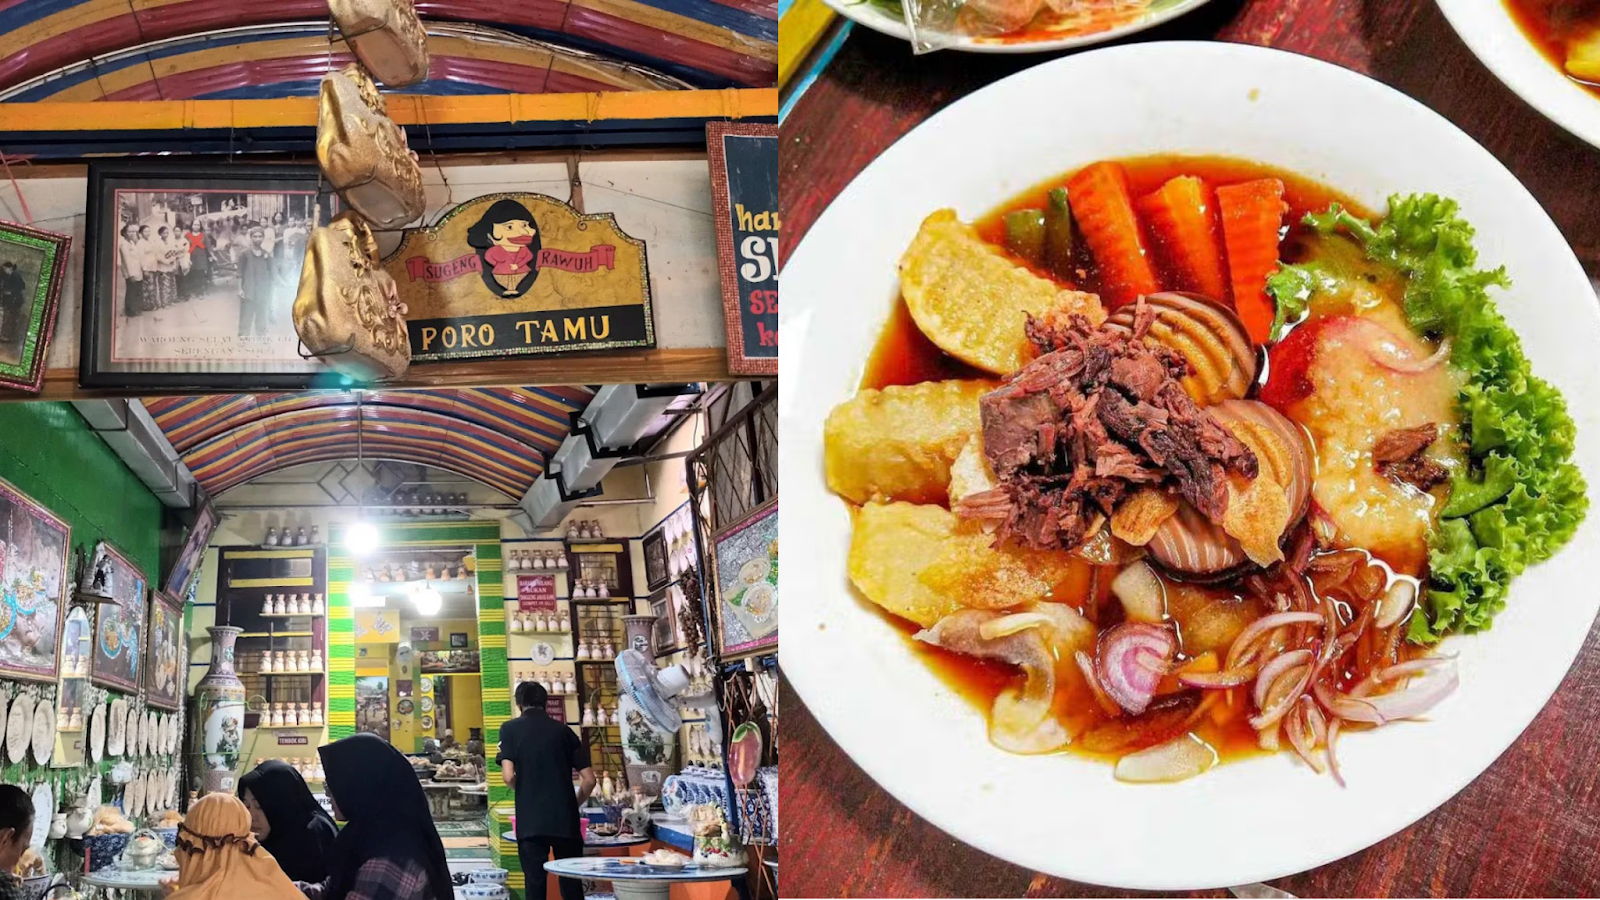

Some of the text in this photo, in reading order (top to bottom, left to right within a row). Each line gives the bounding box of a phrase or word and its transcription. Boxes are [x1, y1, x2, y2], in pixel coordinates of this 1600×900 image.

[425, 251, 593, 279] SUGENG RAWUH
[421, 315, 610, 351] PORO TAMU
[756, 321, 778, 347] k
